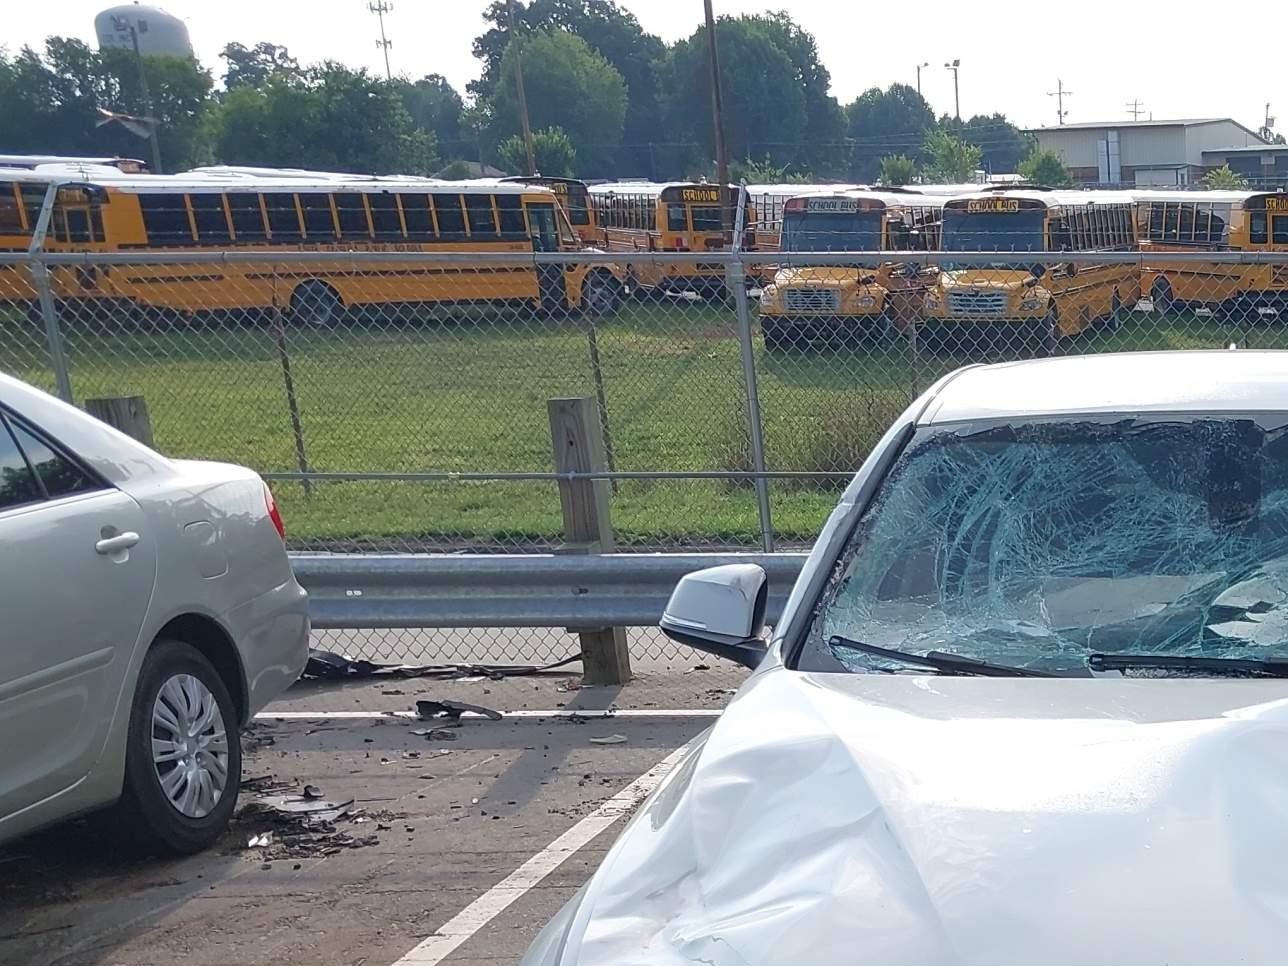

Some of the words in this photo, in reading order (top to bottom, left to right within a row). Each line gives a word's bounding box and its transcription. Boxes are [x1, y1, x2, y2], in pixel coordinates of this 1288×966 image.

[809, 200, 837, 210] SCHOOL
[840, 200, 857, 210] BUS
[970, 200, 997, 210] SCHOOL
[1001, 200, 1018, 210] BUS
